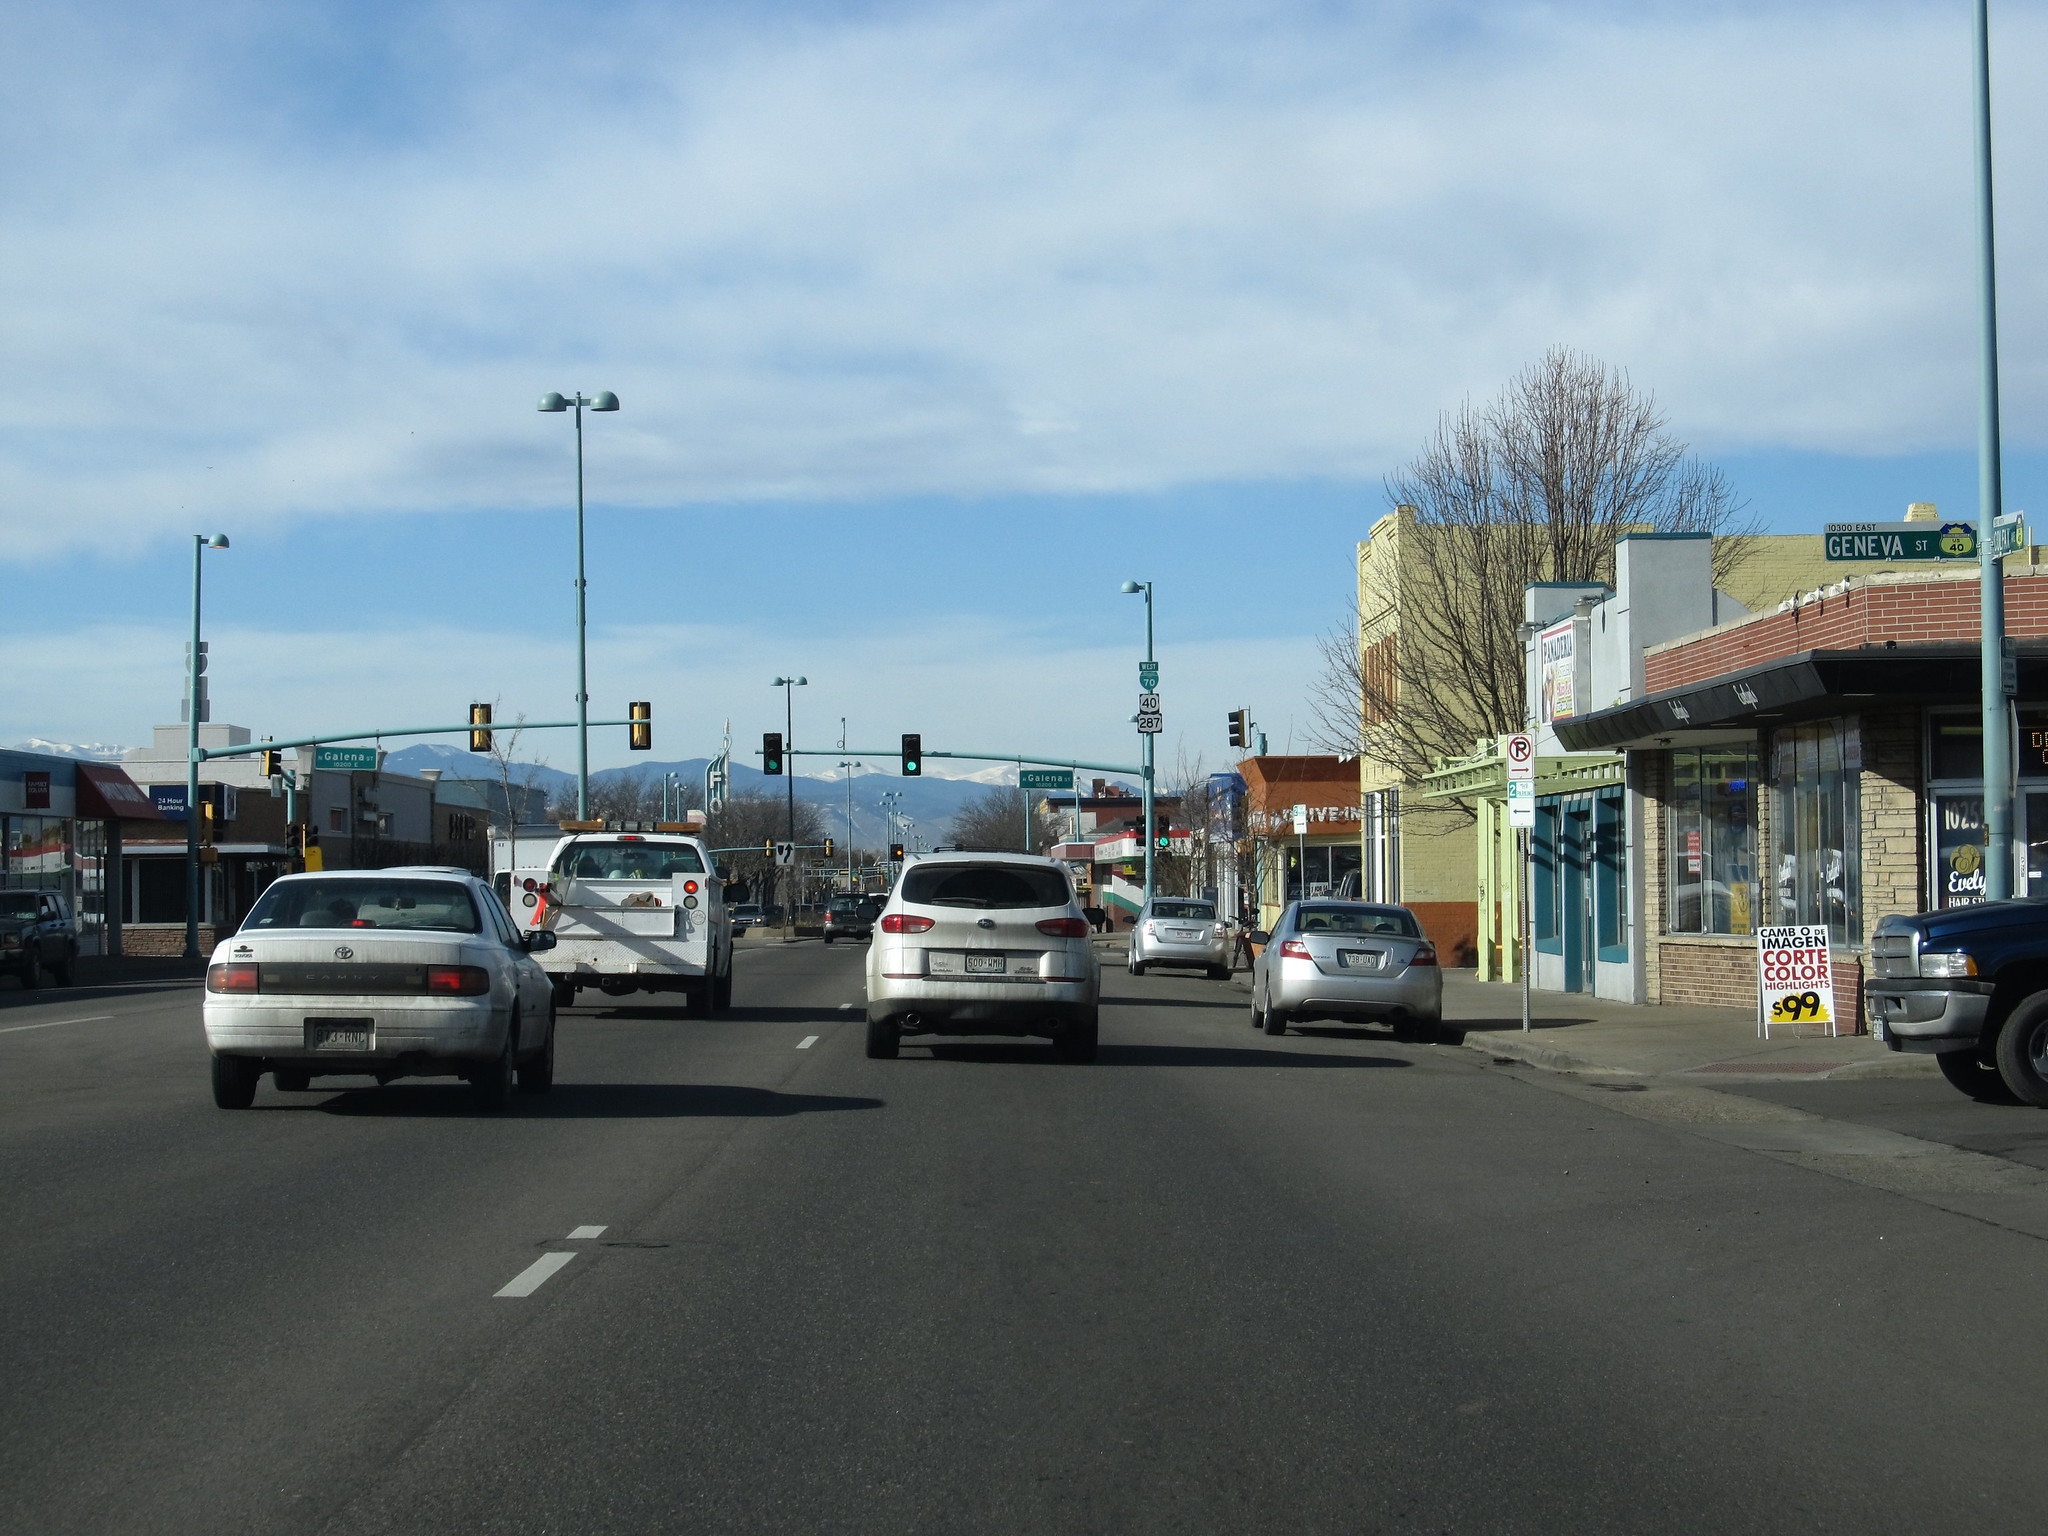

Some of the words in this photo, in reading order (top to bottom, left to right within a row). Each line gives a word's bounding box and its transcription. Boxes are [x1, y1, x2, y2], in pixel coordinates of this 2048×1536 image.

[1828, 534, 1904, 557] GENEVA
[1915, 540, 1928, 551] ST
[1142, 698, 1157, 708] 40
[1140, 718, 1160, 728] 287
[324, 752, 364, 761] Galena
[1509, 784, 1516, 796] 2
[1949, 897, 1970, 908] HAIR
[1762, 936, 1826, 949] IMAGEN
[1763, 949, 1828, 966] CORTE
[1764, 965, 1829, 981] COLOR
[1765, 980, 1831, 991] HIGHLIGHTS
[1772, 991, 1821, 1021] $99
